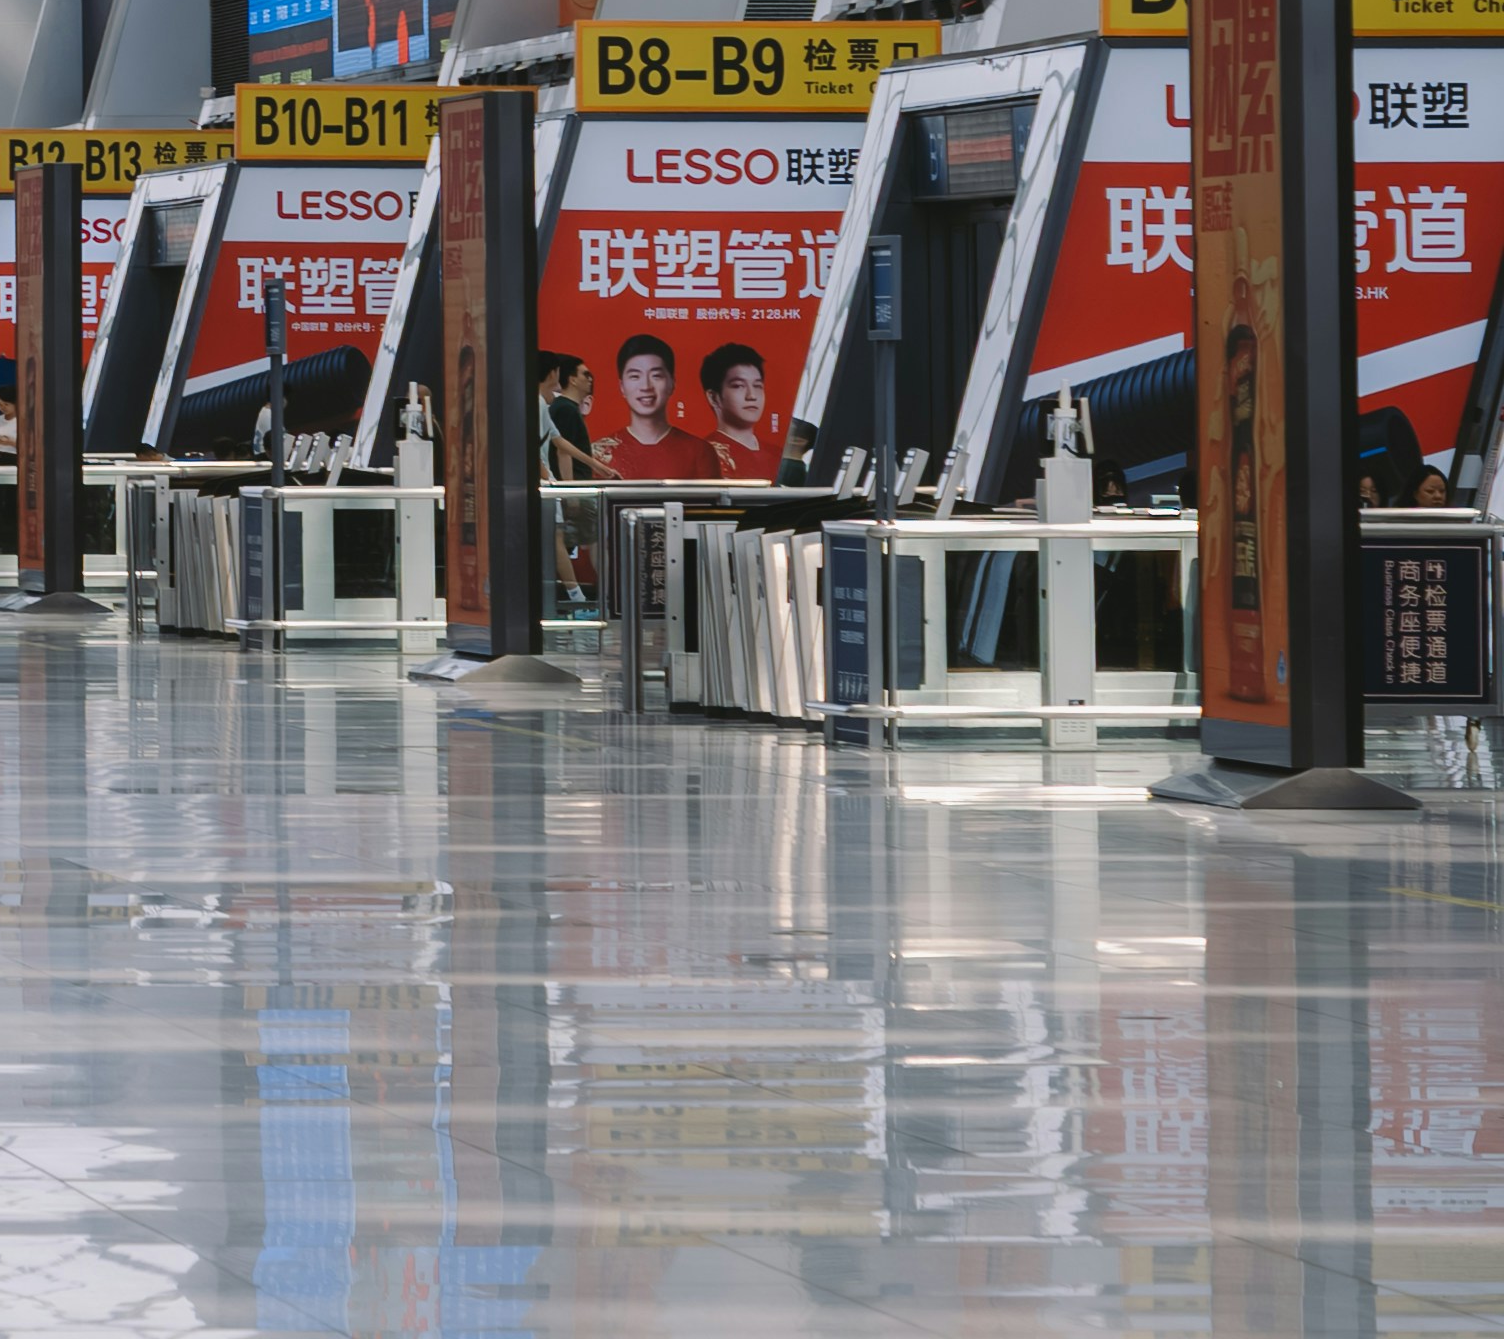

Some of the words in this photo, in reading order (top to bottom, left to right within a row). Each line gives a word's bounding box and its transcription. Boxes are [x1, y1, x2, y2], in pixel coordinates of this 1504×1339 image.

[597, 35, 785, 96] B8-B9
[804, 80, 854, 95] Ticket
[255, 96, 407, 147] B10-B11
[1368, 82, 1470, 130] 联塑
[626, 148, 779, 185] LESSO
[276, 189, 404, 221] LESSO
[644, 307, 689, 321] 中国联塑
[752, 307, 801, 321] 2128.HK
[1398, 559, 1423, 684] 商务座便捷
[1424, 584, 1448, 684] 检票通道
